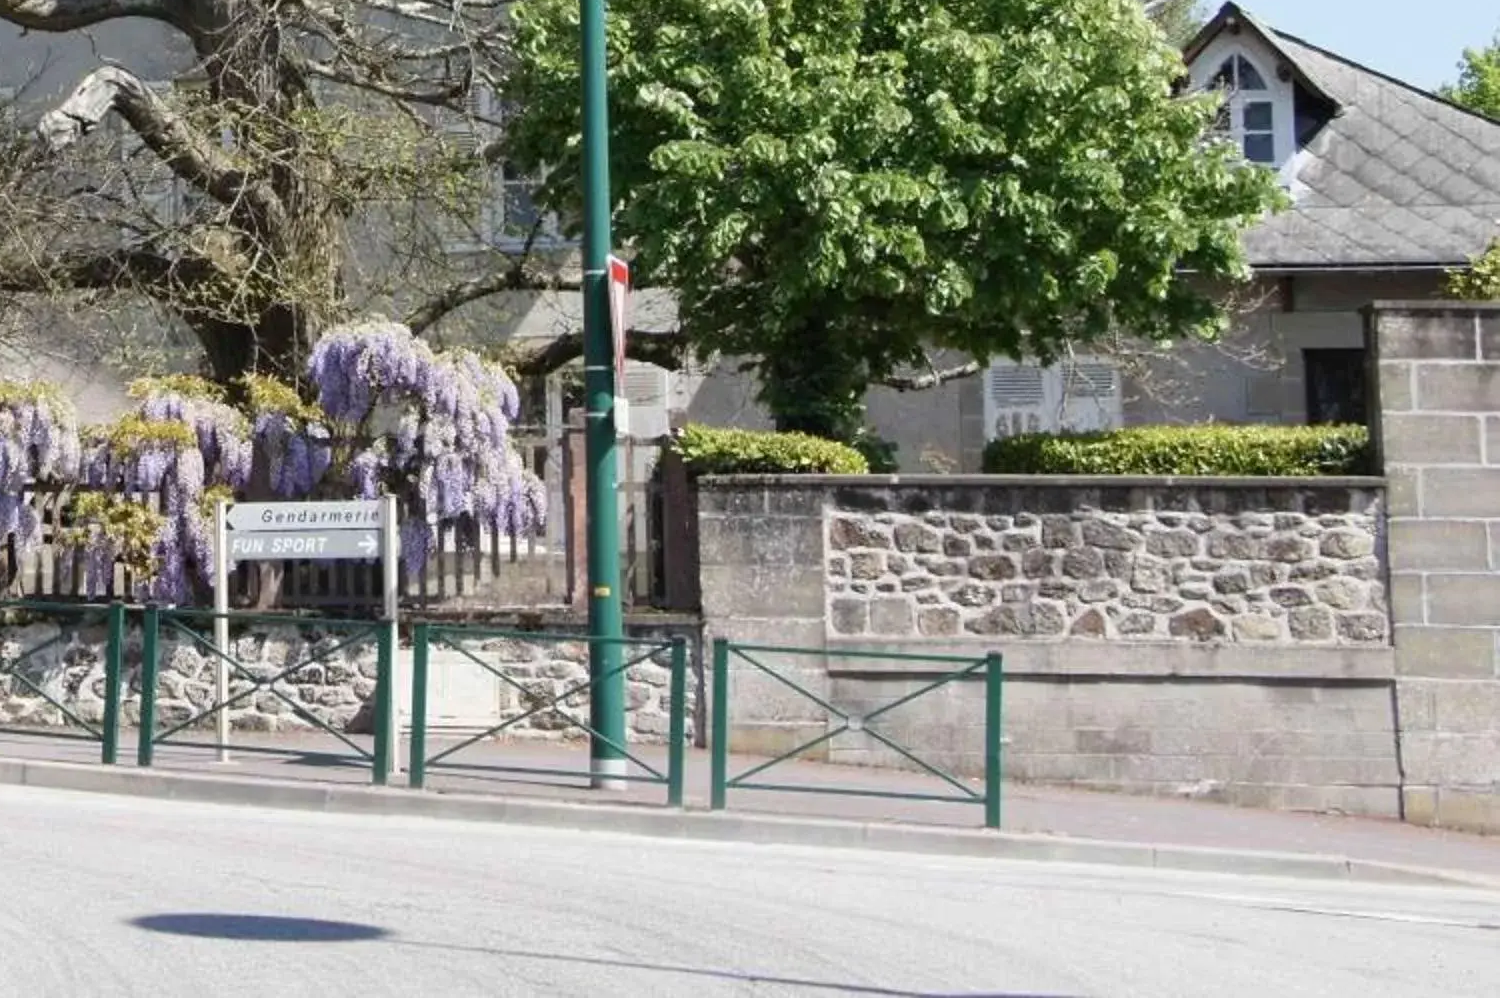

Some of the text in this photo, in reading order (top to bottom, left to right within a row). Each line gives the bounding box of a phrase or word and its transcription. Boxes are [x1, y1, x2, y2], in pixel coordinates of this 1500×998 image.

[261, 509, 379, 523] Gendarmerie
[232, 537, 328, 553] FUN SPORT
